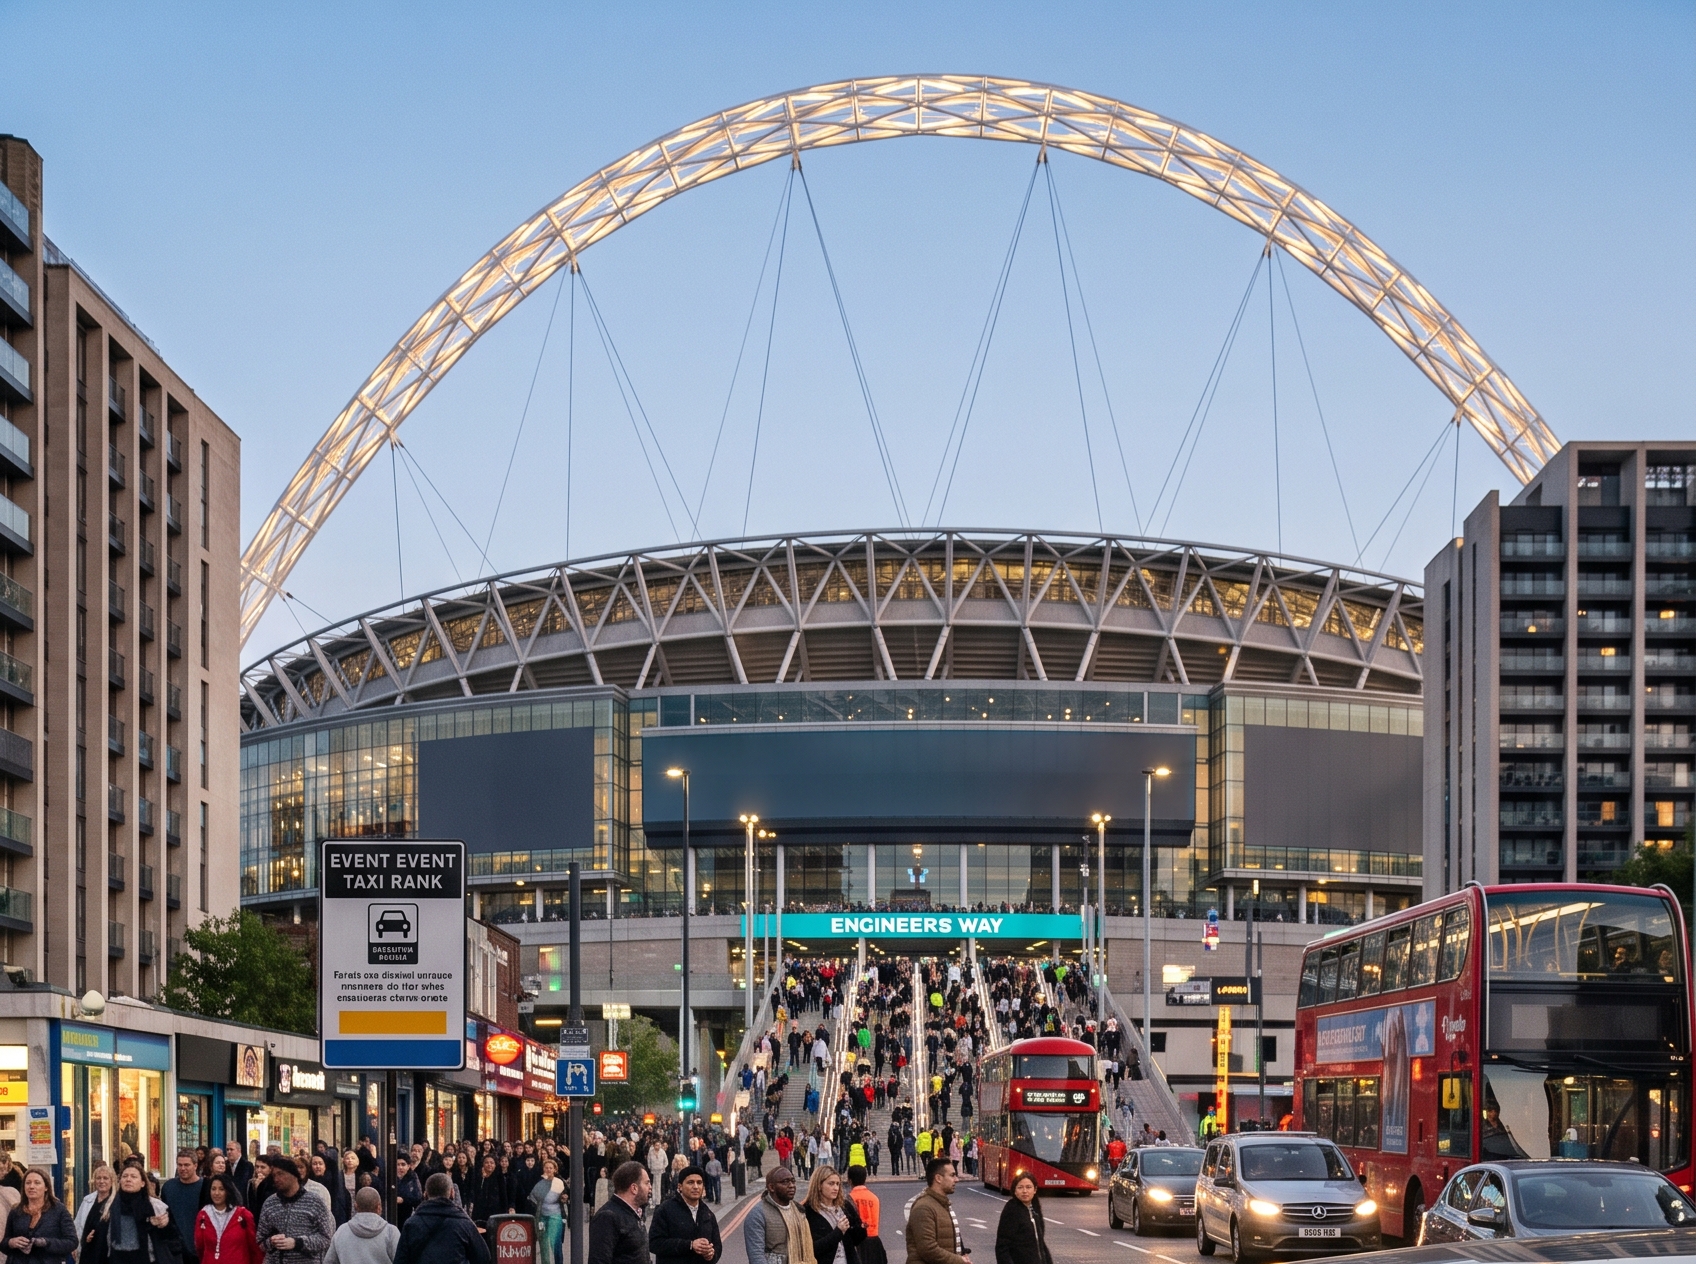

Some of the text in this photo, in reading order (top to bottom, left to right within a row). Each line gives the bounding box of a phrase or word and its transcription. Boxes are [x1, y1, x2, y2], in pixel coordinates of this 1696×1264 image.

[330, 853, 457, 868] EVENT EVENT
[343, 874, 443, 889] TAXI RANK
[831, 917, 1003, 933] ENGINEERS WAY
[386, 982, 399, 991] do
